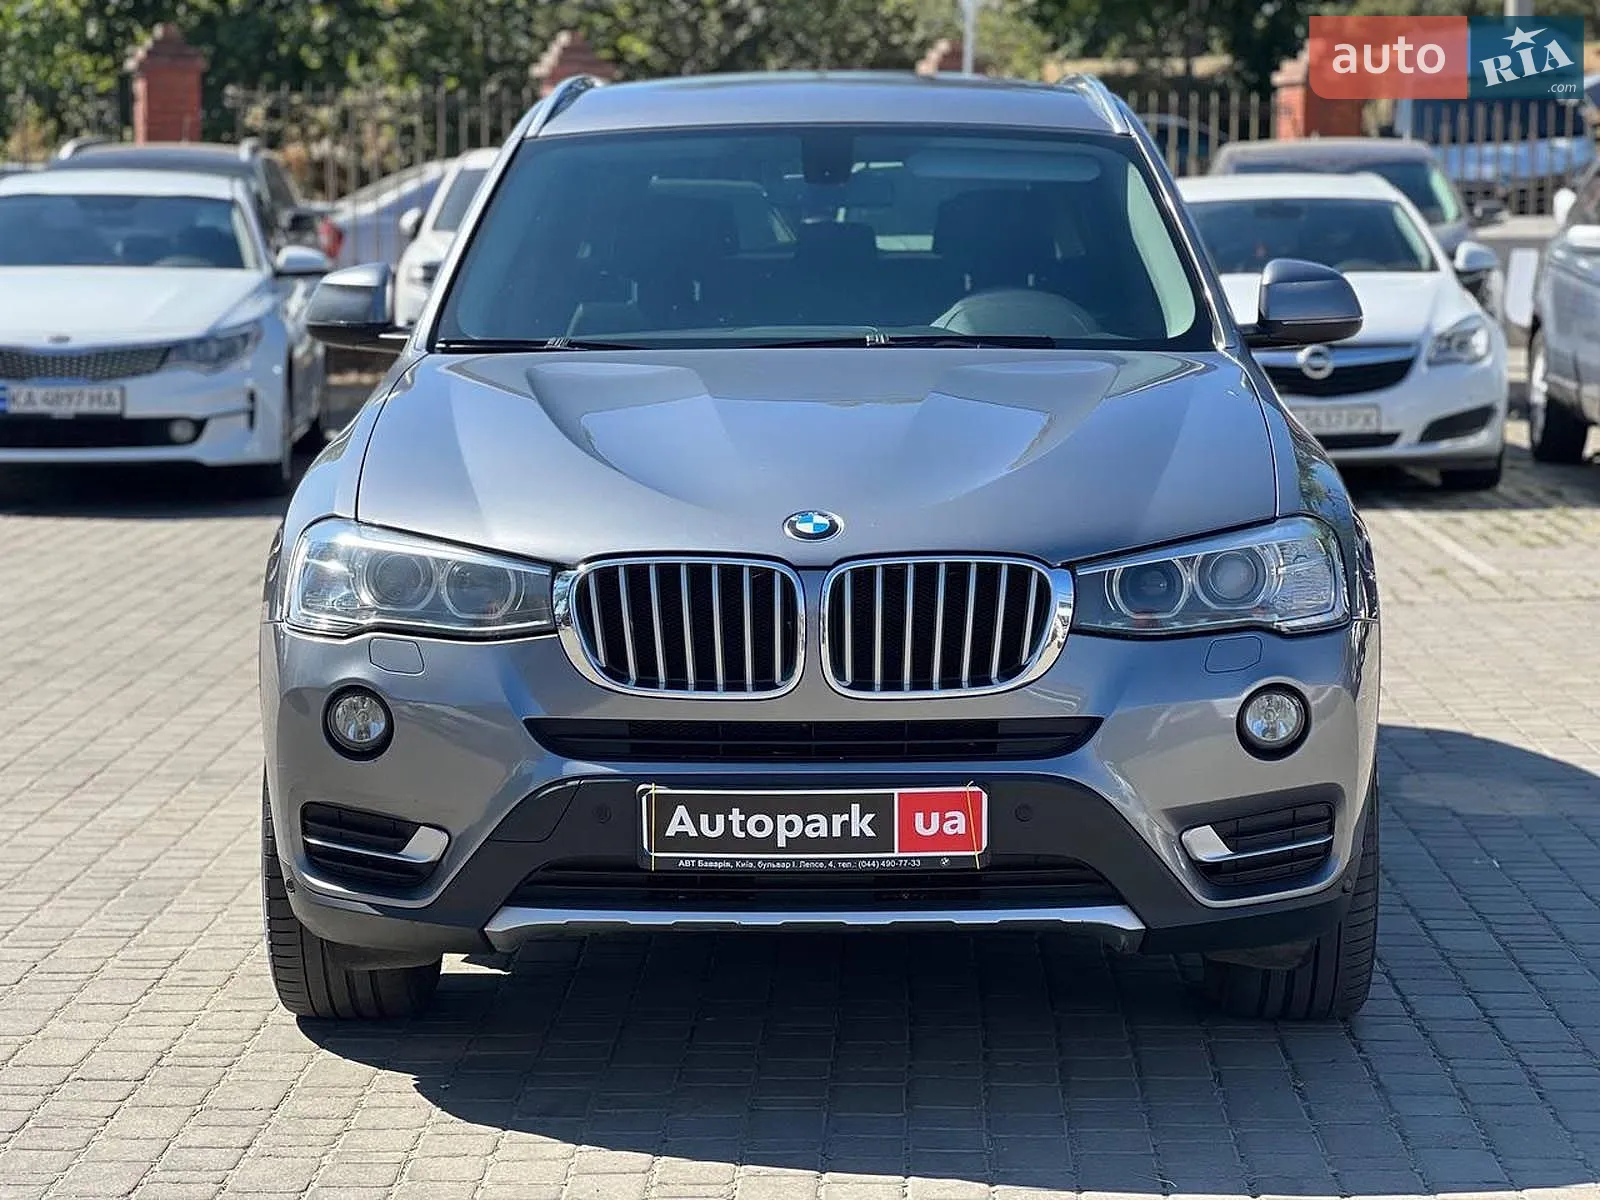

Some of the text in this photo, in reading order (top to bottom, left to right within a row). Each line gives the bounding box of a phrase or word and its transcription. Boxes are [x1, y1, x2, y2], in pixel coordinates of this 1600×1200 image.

[664, 803, 967, 848] Autopark ua
[858, 859, 880, 869] (044)
[880, 858, 921, 868] 490-77-33
